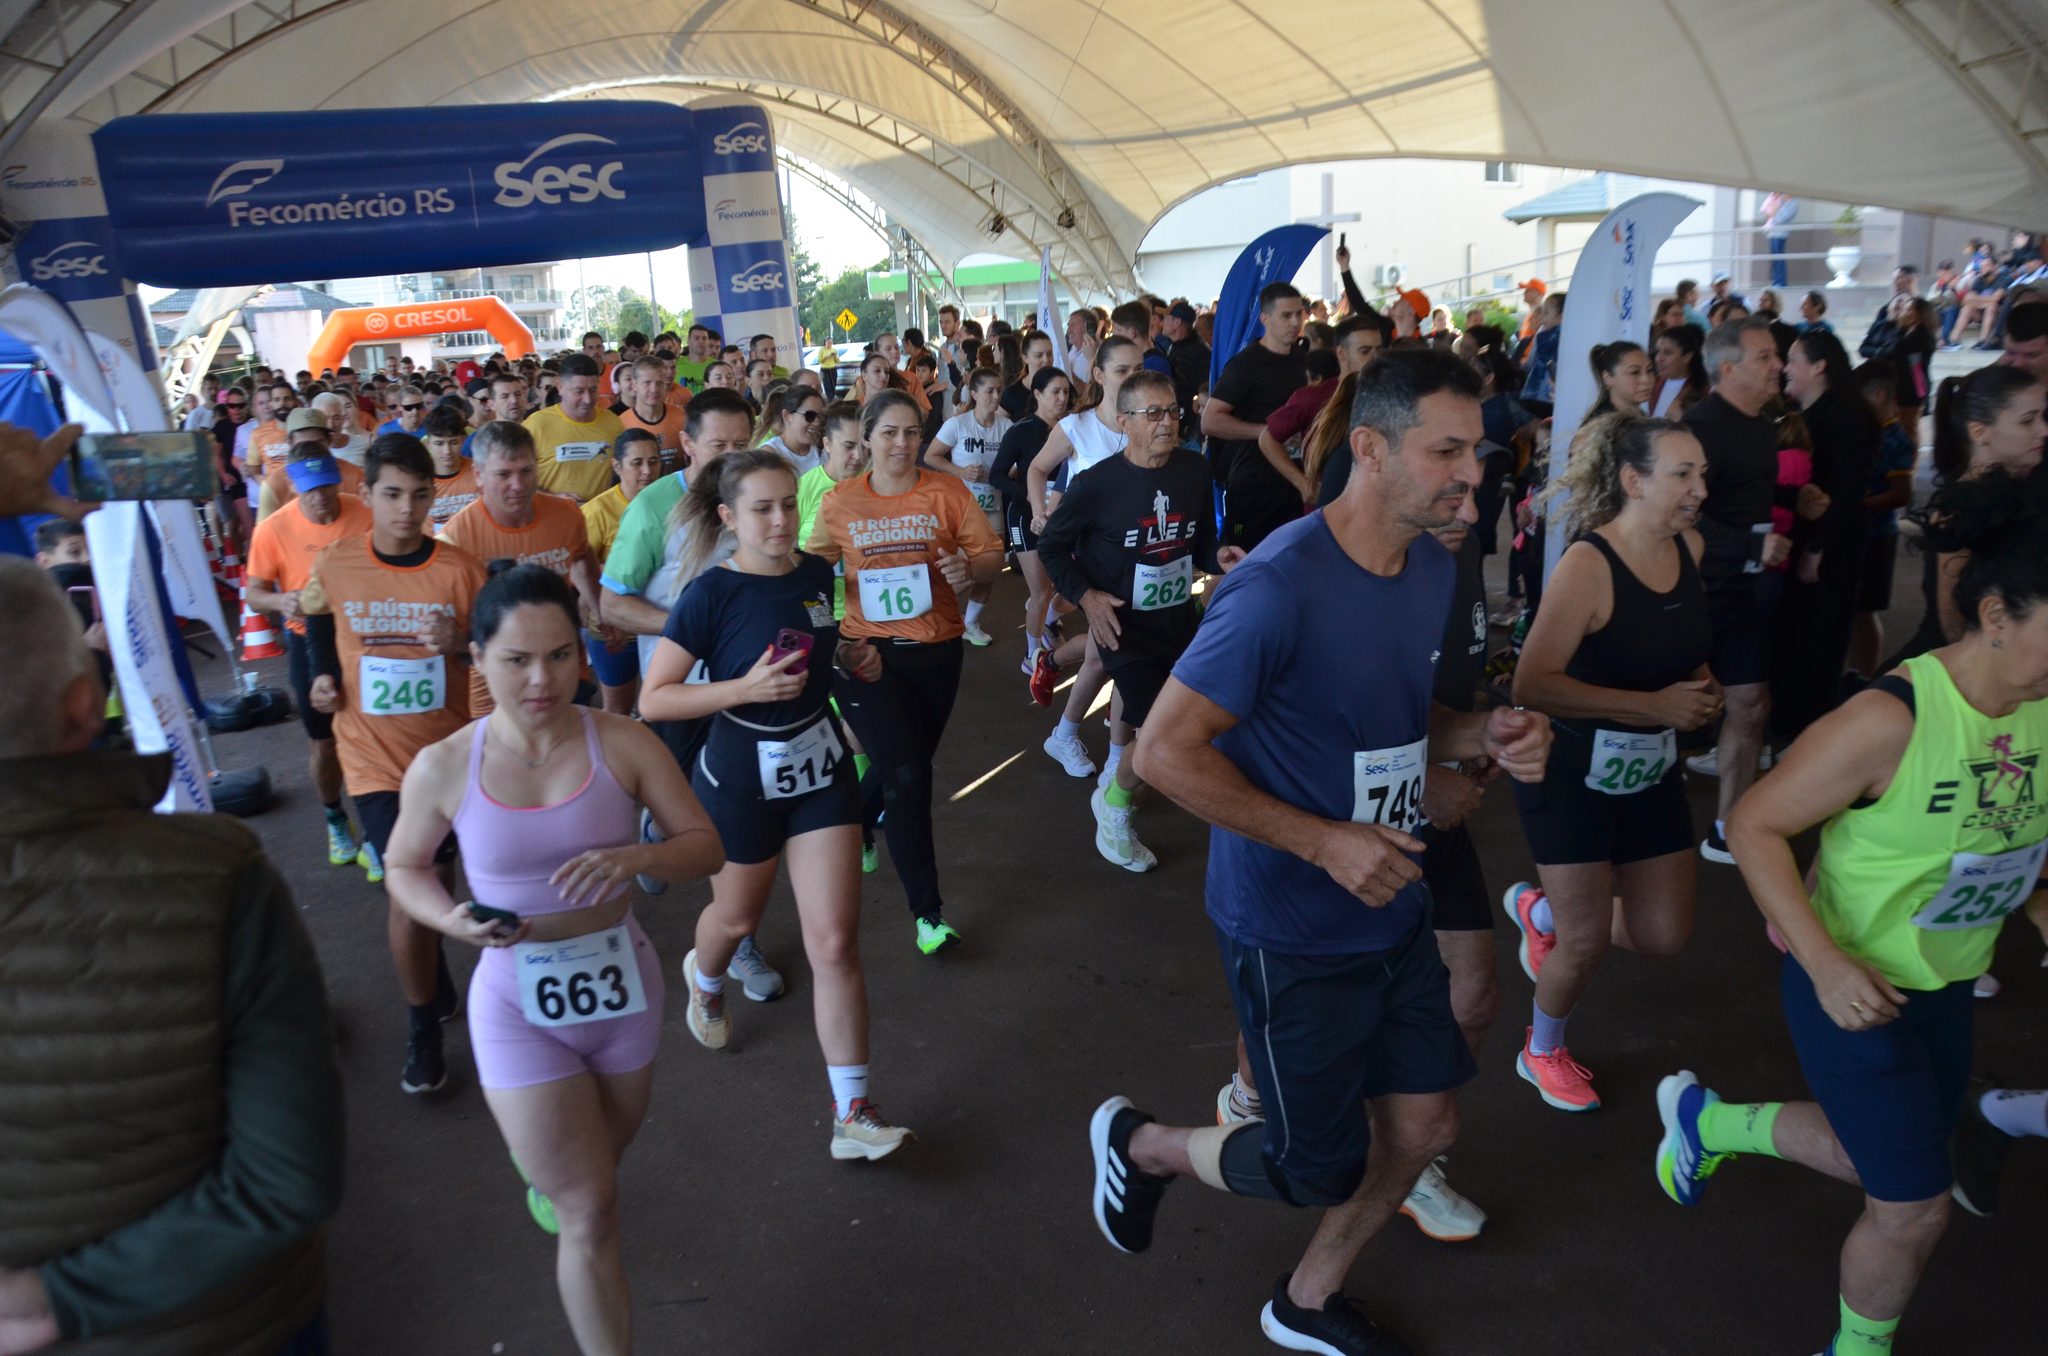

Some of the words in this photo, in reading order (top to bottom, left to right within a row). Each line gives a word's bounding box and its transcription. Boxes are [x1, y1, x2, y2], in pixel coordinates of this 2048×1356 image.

[714, 134, 767, 155] Sesc
[493, 161, 625, 208] Sesc
[228, 193, 406, 228] Fecomércio
[415, 188, 456, 215] RS
[718, 209, 769, 221] Fecomércio
[31, 255, 109, 280] Sesc
[731, 272, 784, 293] Sesc
[394, 307, 474, 328] CRESOL
[853, 527, 936, 548] REGIONAL
[867, 514, 939, 531] RÚSTICA
[879, 587, 913, 616] 16
[1141, 575, 1187, 607] 262
[372, 679, 435, 710] 246
[776, 746, 837, 794] 514
[1599, 756, 1665, 789] 264
[1368, 775, 1421, 829] 749
[1931, 875, 2025, 924] 252
[536, 964, 629, 1021] 663
